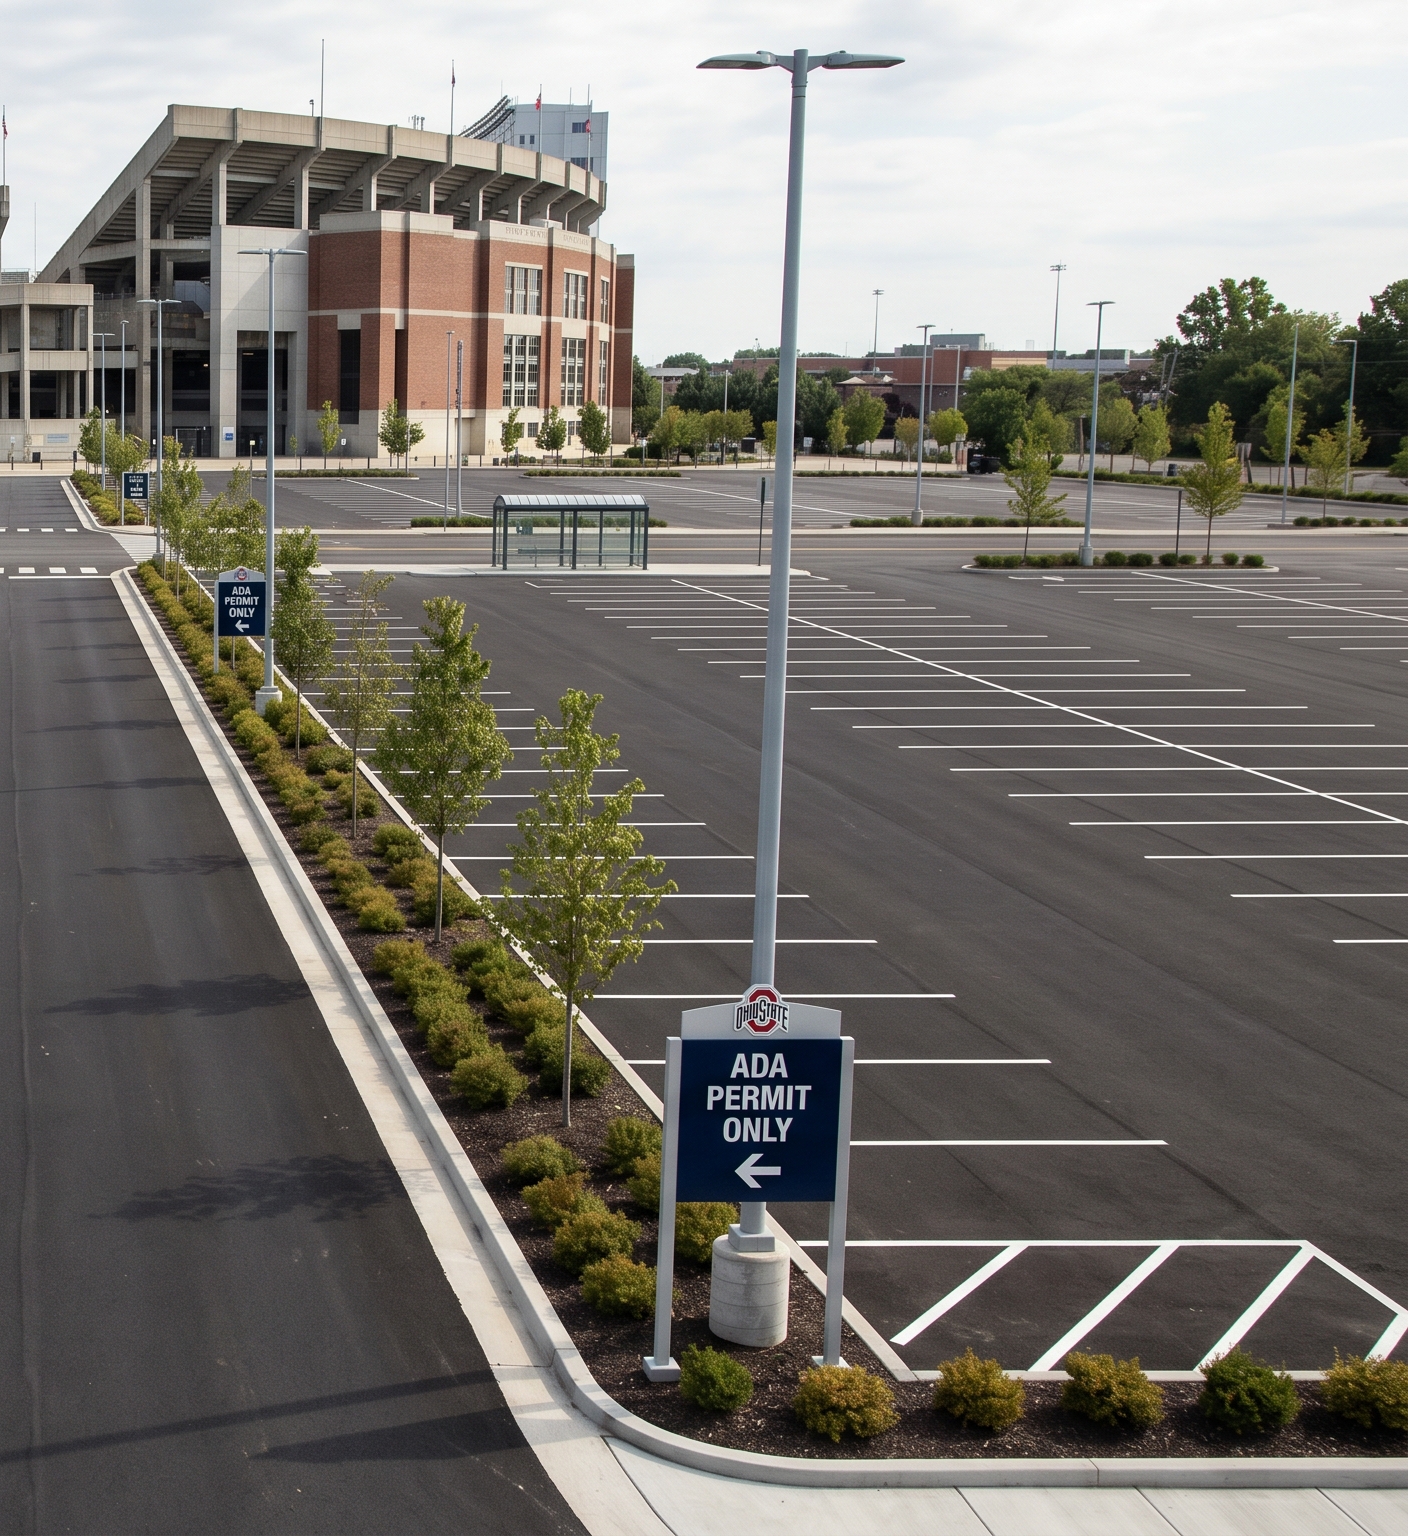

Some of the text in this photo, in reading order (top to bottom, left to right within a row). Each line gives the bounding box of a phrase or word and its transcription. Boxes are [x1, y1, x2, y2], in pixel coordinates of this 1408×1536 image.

[232, 586, 251, 595] ADA
[229, 607, 255, 617] ONLY
[730, 1053, 788, 1078] ADA
[707, 1085, 812, 1111] PERMIT
[723, 1117, 793, 1143] ONLY
